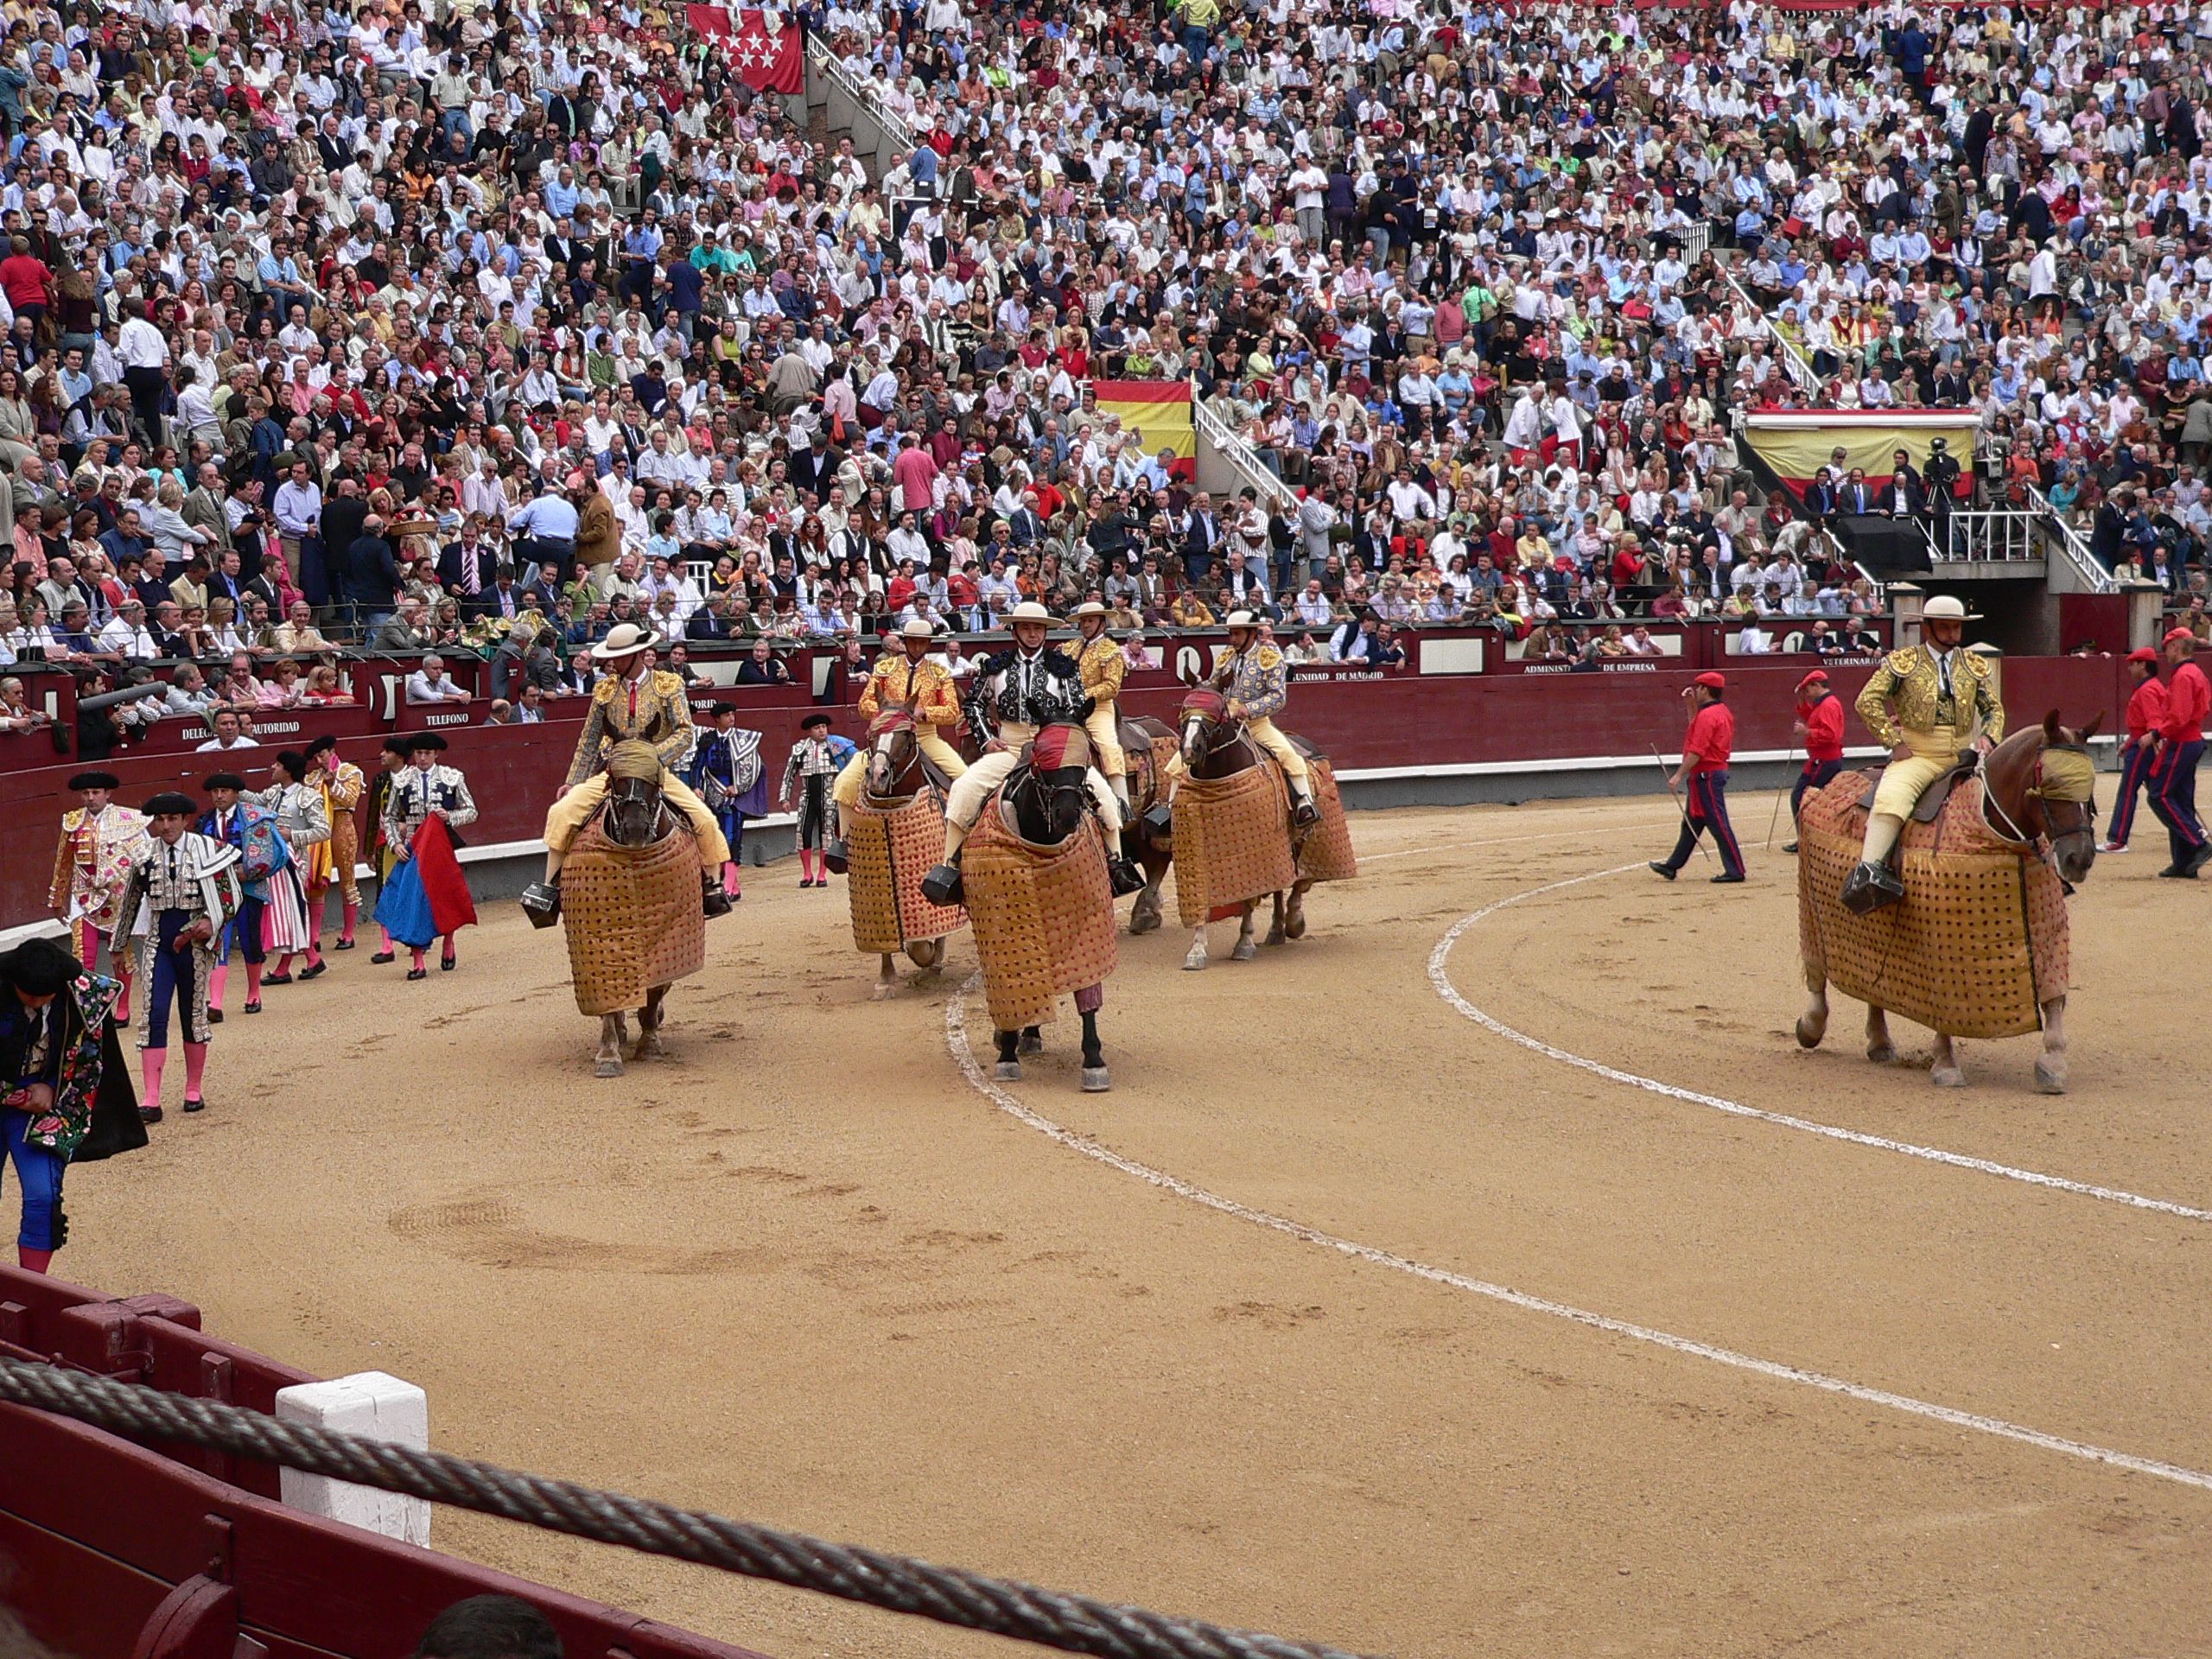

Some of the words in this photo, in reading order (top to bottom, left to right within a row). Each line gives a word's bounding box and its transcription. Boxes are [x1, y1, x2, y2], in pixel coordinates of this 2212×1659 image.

[1618, 663, 1656, 671] EMPRESA
[1335, 672, 1347, 681] DE
[1349, 671, 1383, 681] MADRID
[426, 713, 469, 726] TELEFONO
[252, 721, 300, 734] AUTORIDAD
